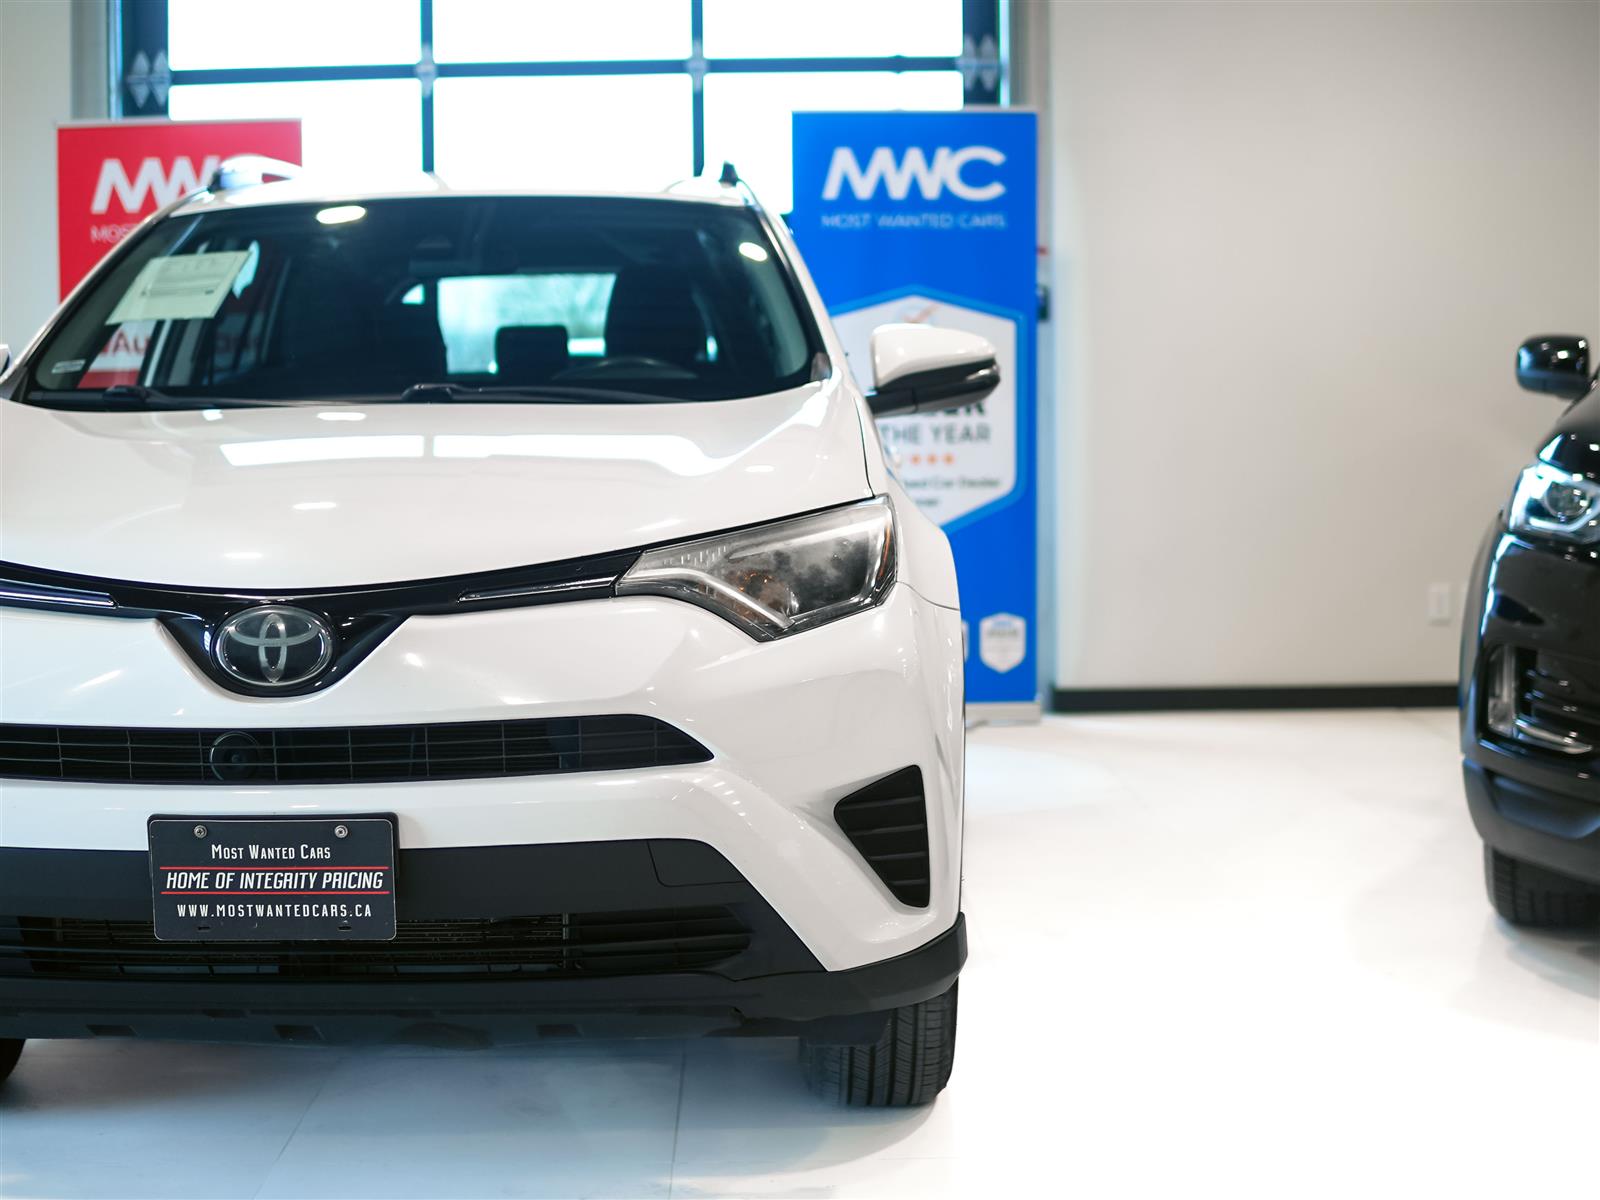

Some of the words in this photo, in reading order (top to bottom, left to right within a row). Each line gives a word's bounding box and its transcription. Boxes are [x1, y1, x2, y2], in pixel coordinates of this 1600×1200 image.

[821, 146, 1006, 201] MWC
[91, 155, 220, 214] MW
[821, 213, 871, 228] MOST
[878, 213, 954, 228] WANTED
[959, 213, 1005, 228] CARS
[90, 223, 140, 243] MOS
[879, 422, 920, 443] THE
[930, 422, 991, 443] YEAR
[211, 844, 244, 859] MOST
[249, 844, 295, 859] WANTED
[300, 844, 331, 859] CARS
[166, 872, 210, 889] HOME
[215, 872, 235, 889] OF
[239, 872, 317, 889] INTEGRITY
[322, 872, 384, 889] PRICING
[177, 904, 372, 917] WWW.MOSTWANTEDCARS.CA
